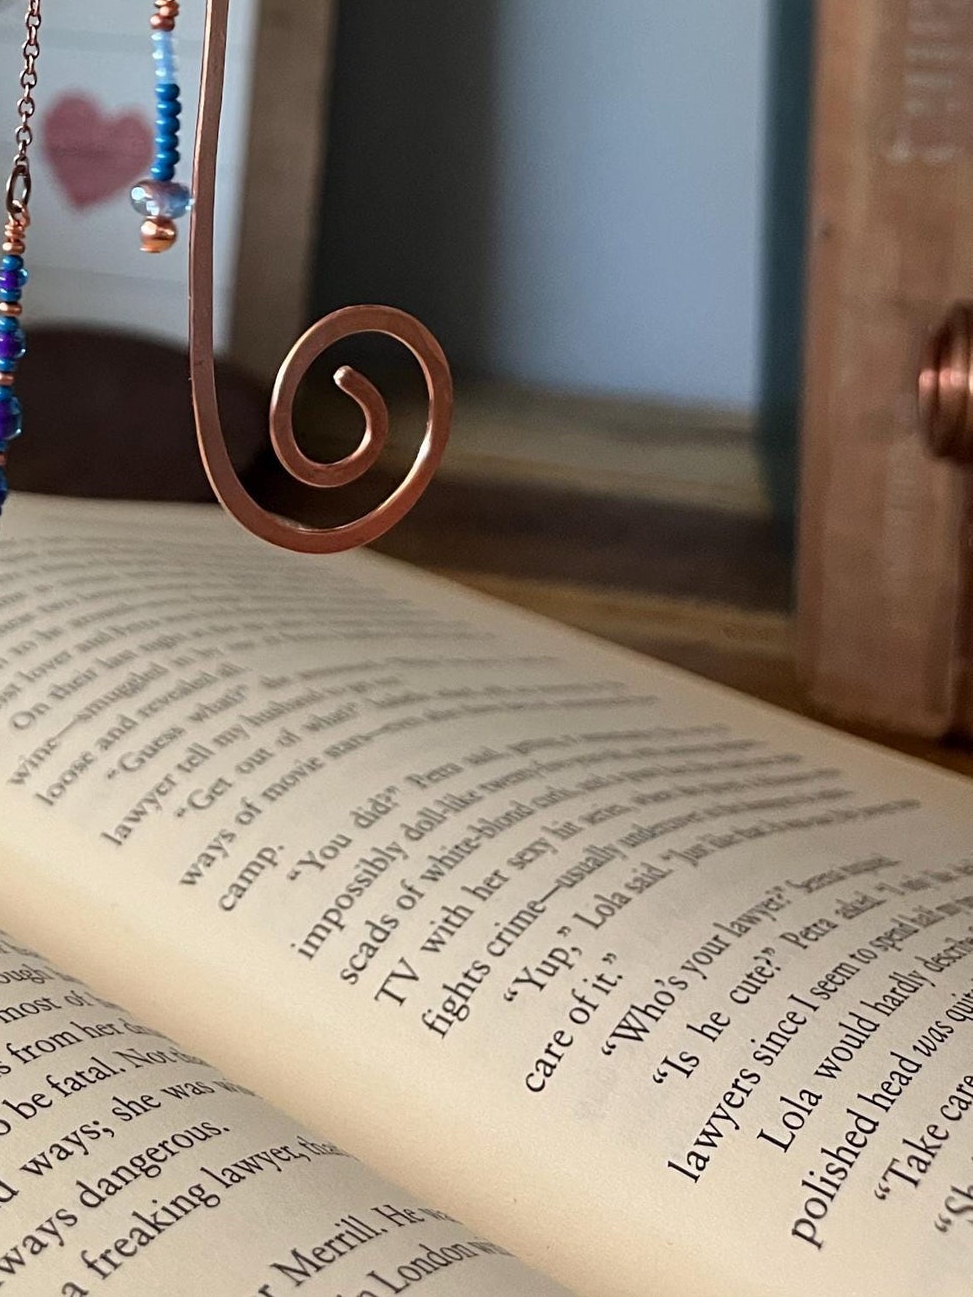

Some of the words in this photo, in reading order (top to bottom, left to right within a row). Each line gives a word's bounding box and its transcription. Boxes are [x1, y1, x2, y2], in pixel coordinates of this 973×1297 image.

[9, 701, 51, 731] On
[34, 750, 97, 807] loose
[94, 713, 139, 751] and
[101, 774, 177, 847] lawyer
[176, 742, 216, 774] tell
[212, 722, 252, 748] my
[176, 775, 233, 819] “Get
[235, 746, 275, 775] out
[179, 832, 237, 886] ways
[235, 797, 263, 826] of
[261, 754, 326, 803] movie
[219, 845, 284, 912] camp.
[287, 834, 353, 882] “You
[291, 841, 409, 961] impossibly
[400, 791, 483, 842] doll-like
[339, 914, 400, 986] scads
[396, 878, 425, 911] of
[419, 801, 535, 883] white-blond
[573, 890, 631, 930] Lola
[626, 859, 674, 896] said.
[373, 956, 420, 1007] TV
[419, 904, 475, 953] with
[460, 869, 510, 902] her
[508, 837, 559, 870] sexy
[680, 934, 730, 981] your
[8, 1024, 84, 1065] from
[421, 959, 491, 1040] fights
[525, 1029, 574, 1093] care
[568, 985, 598, 1027] of
[652, 1050, 700, 1084] “Is
[685, 1011, 731, 1044] he
[781, 916, 839, 951] Petra
[1, 1093, 54, 1121] be
[46, 1057, 126, 1098] fatal.
[667, 1068, 761, 1184] lawyers
[752, 1011, 808, 1067] since
[787, 993, 821, 1013] I
[809, 962, 862, 1001] seem
[848, 948, 879, 965] to
[756, 1088, 823, 1154] Lola
[812, 1010, 881, 1080] would
[859, 969, 937, 1018] hardly
[18, 1120, 115, 1177] ways;
[111, 1094, 162, 1123] she
[75, 1121, 231, 1209] dangerous.
[791, 1107, 880, 1252] polished
[856, 1050, 923, 1114] head
[912, 1020, 955, 1058] was
[873, 1123, 950, 1201] “Take
[939, 1075, 973, 1122] care
[81, 1183, 221, 1280] freaking
[366, 1240, 479, 1295] London
